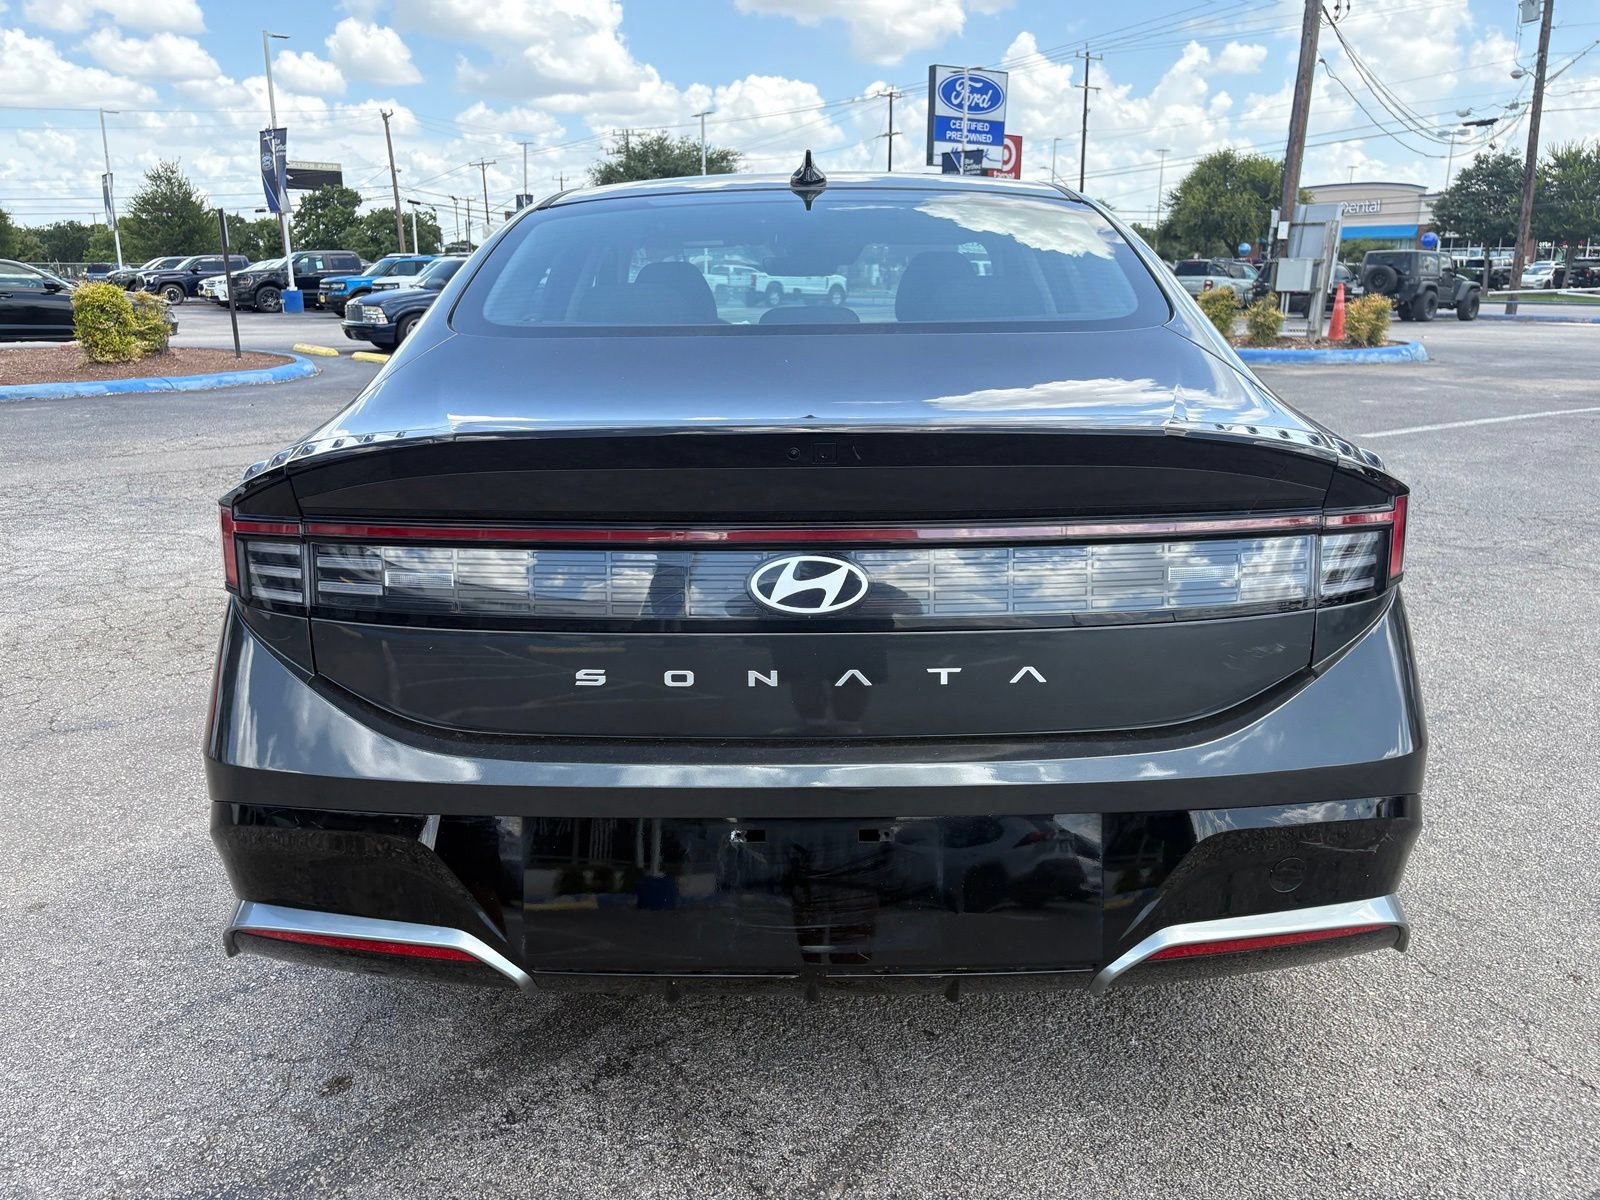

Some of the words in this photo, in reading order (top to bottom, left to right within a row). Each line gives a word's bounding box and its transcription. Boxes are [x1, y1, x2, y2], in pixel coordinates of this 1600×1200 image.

[951, 79, 993, 109] Ford
[950, 119, 990, 132] CETIFIED
[575, 666, 1047, 687] SONATA
